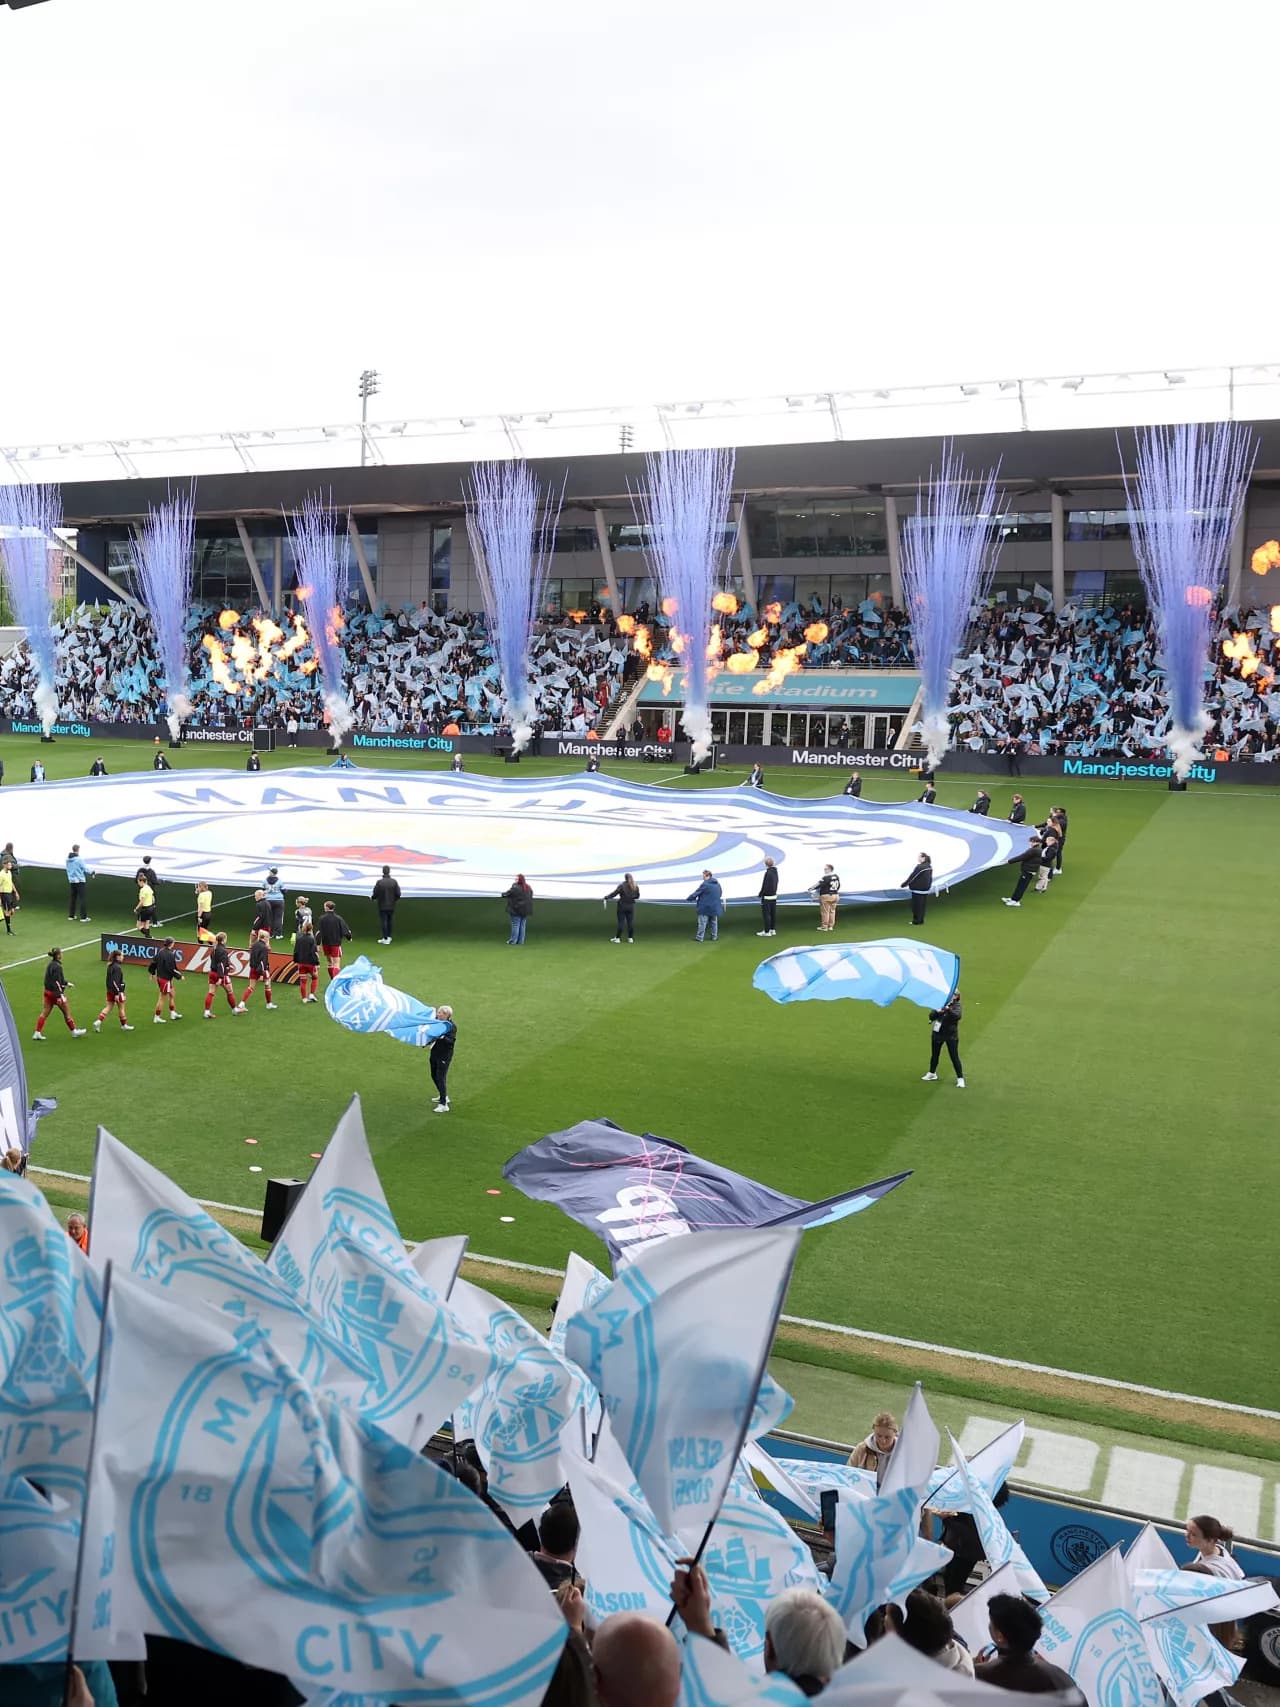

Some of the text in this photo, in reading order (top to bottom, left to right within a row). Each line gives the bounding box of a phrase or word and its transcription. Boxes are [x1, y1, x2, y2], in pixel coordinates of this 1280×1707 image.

[757, 681, 879, 698] tadium
[12, 721, 91, 737] Manchster City
[237, 729, 254, 742] Cit
[353, 734, 453, 752] Manchester City
[792, 749, 923, 770] Manchester City
[1063, 759, 1174, 777] Manchester
[154, 786, 904, 851] MANCHESTER
[295, 1621, 443, 1680] CITY
